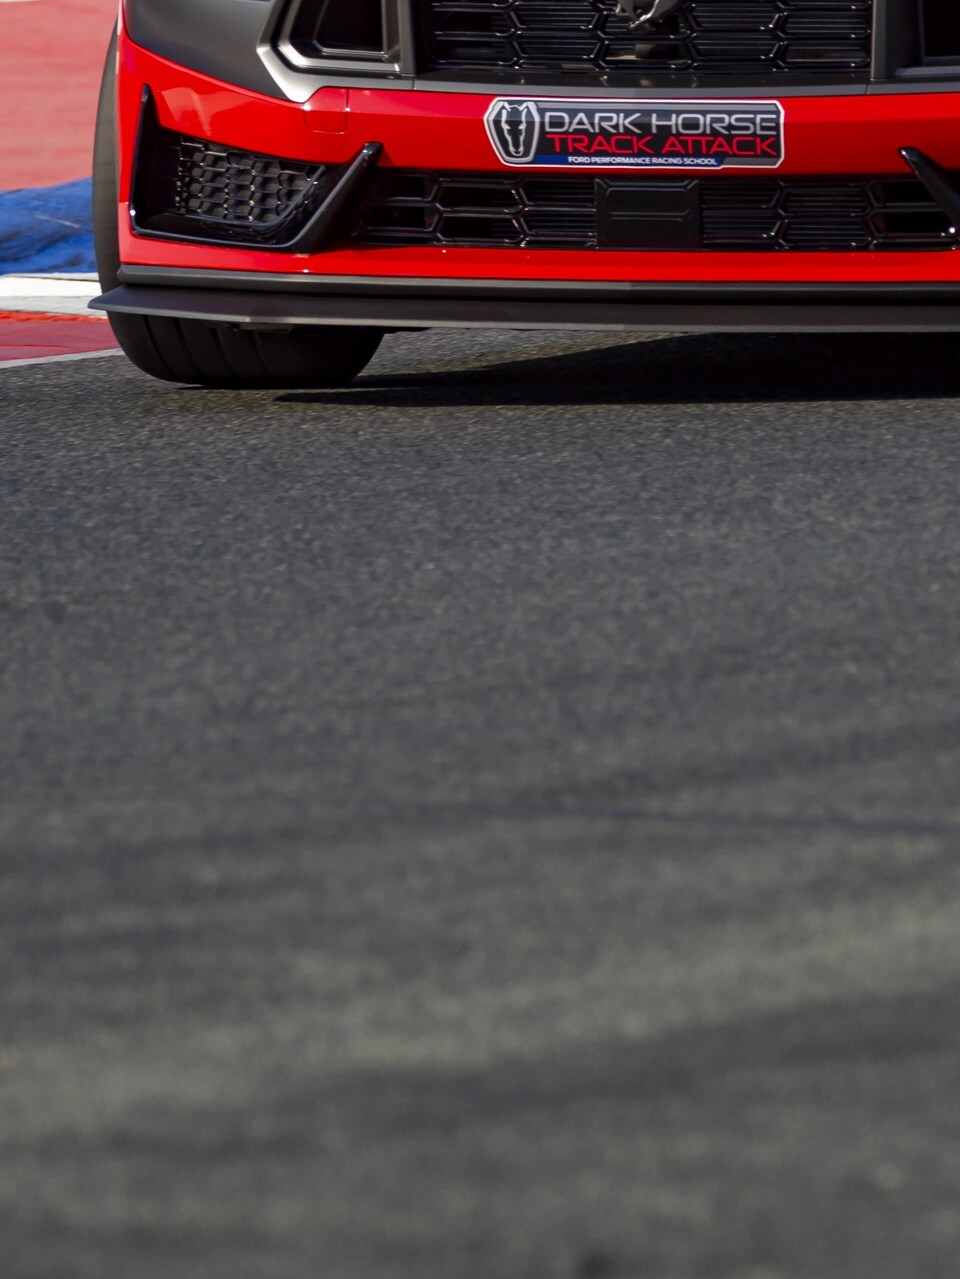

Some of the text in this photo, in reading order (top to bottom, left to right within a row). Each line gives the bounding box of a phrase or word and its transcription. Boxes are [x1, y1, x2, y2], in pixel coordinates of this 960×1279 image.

[544, 111, 777, 135] DARK HORSE
[545, 134, 778, 156] TRACK ATTACK
[568, 156, 718, 166] FORD PERFORMANCE RACING SCHOOL
